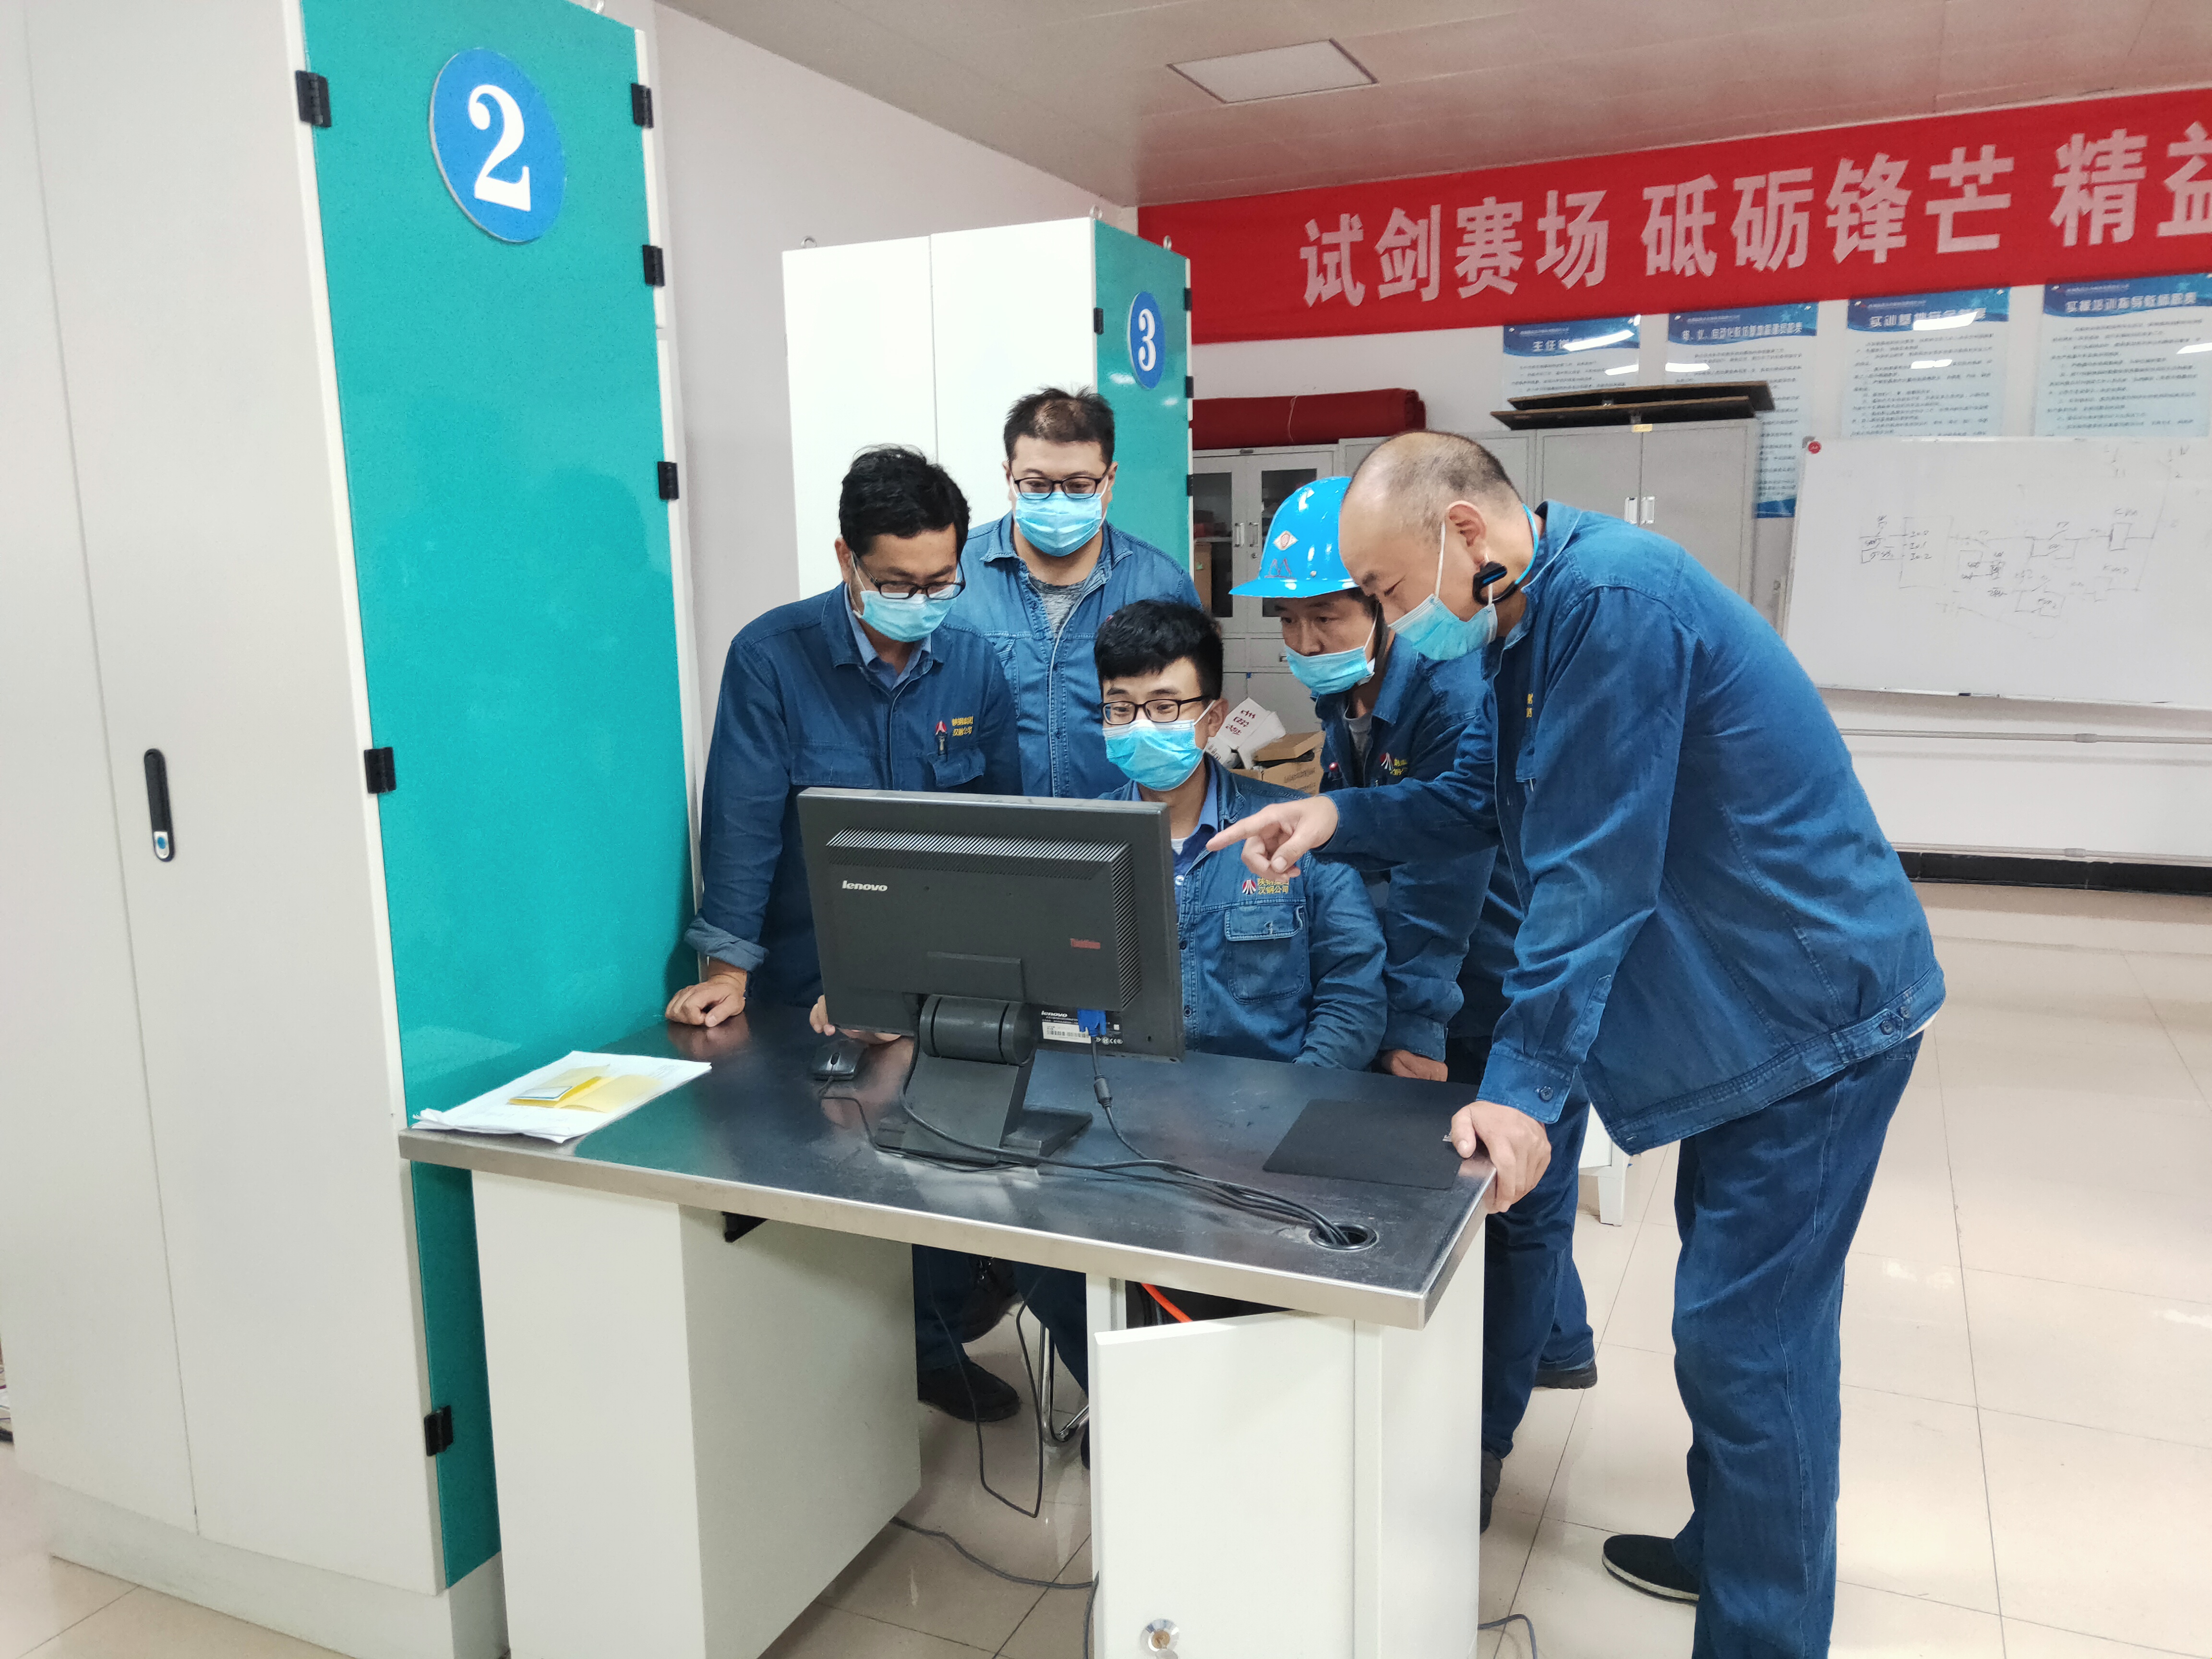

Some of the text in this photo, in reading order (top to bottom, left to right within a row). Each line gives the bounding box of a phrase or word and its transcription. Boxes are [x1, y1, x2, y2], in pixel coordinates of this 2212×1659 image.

[468, 84, 531, 212] 2
[1300, 189, 1609, 308] 试剑赛场
[1640, 144, 2015, 277] 砥砺锋芒
[1138, 308, 1156, 372] 3
[842, 880, 888, 892] lenovo
[1258, 886, 1289, 895] 汉钢公司
